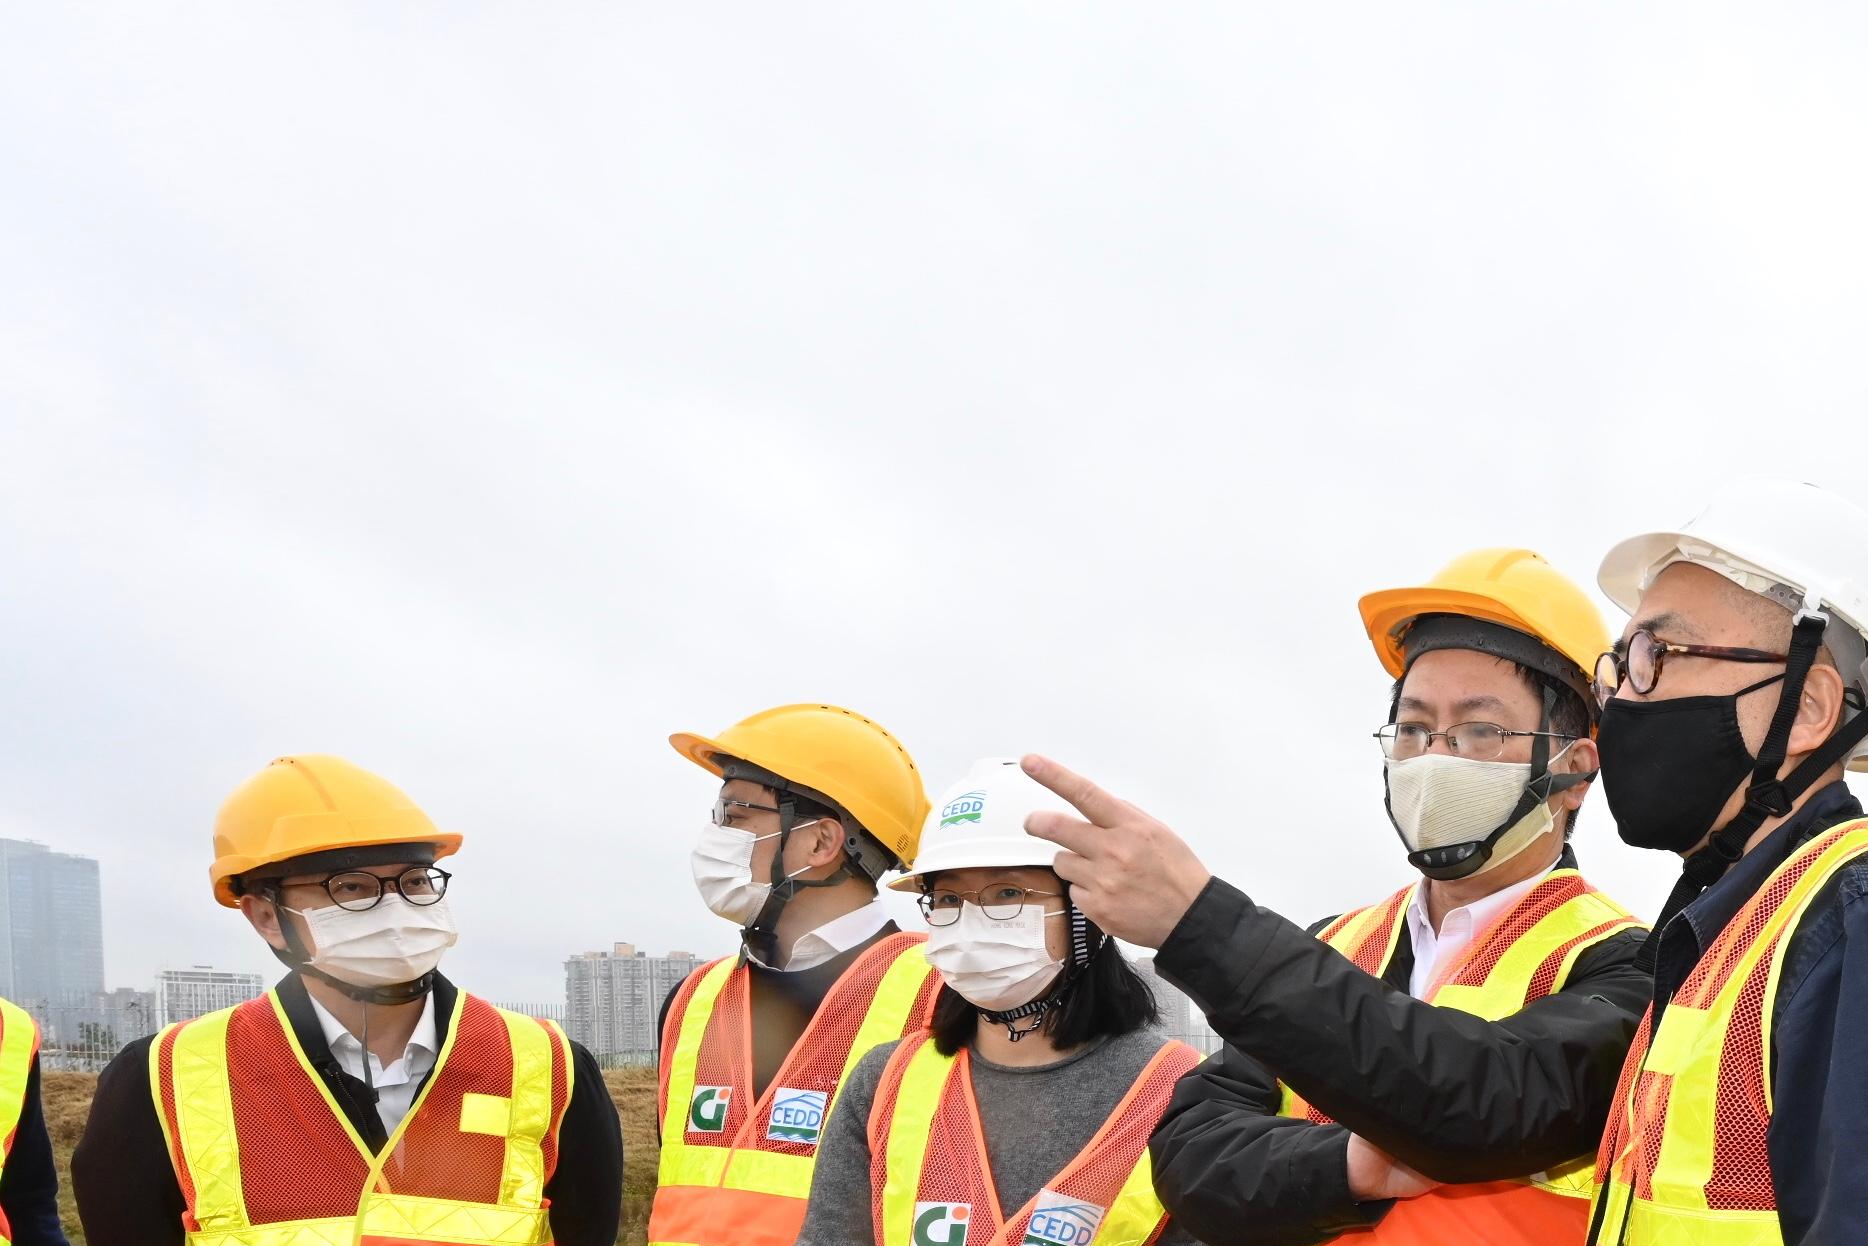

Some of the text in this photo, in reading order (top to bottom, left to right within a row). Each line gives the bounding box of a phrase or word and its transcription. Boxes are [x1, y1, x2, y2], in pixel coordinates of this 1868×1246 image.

[942, 801, 983, 817] CEDD
[772, 1107, 821, 1128] CEDD
[1029, 1213, 1092, 1246] CEDD
